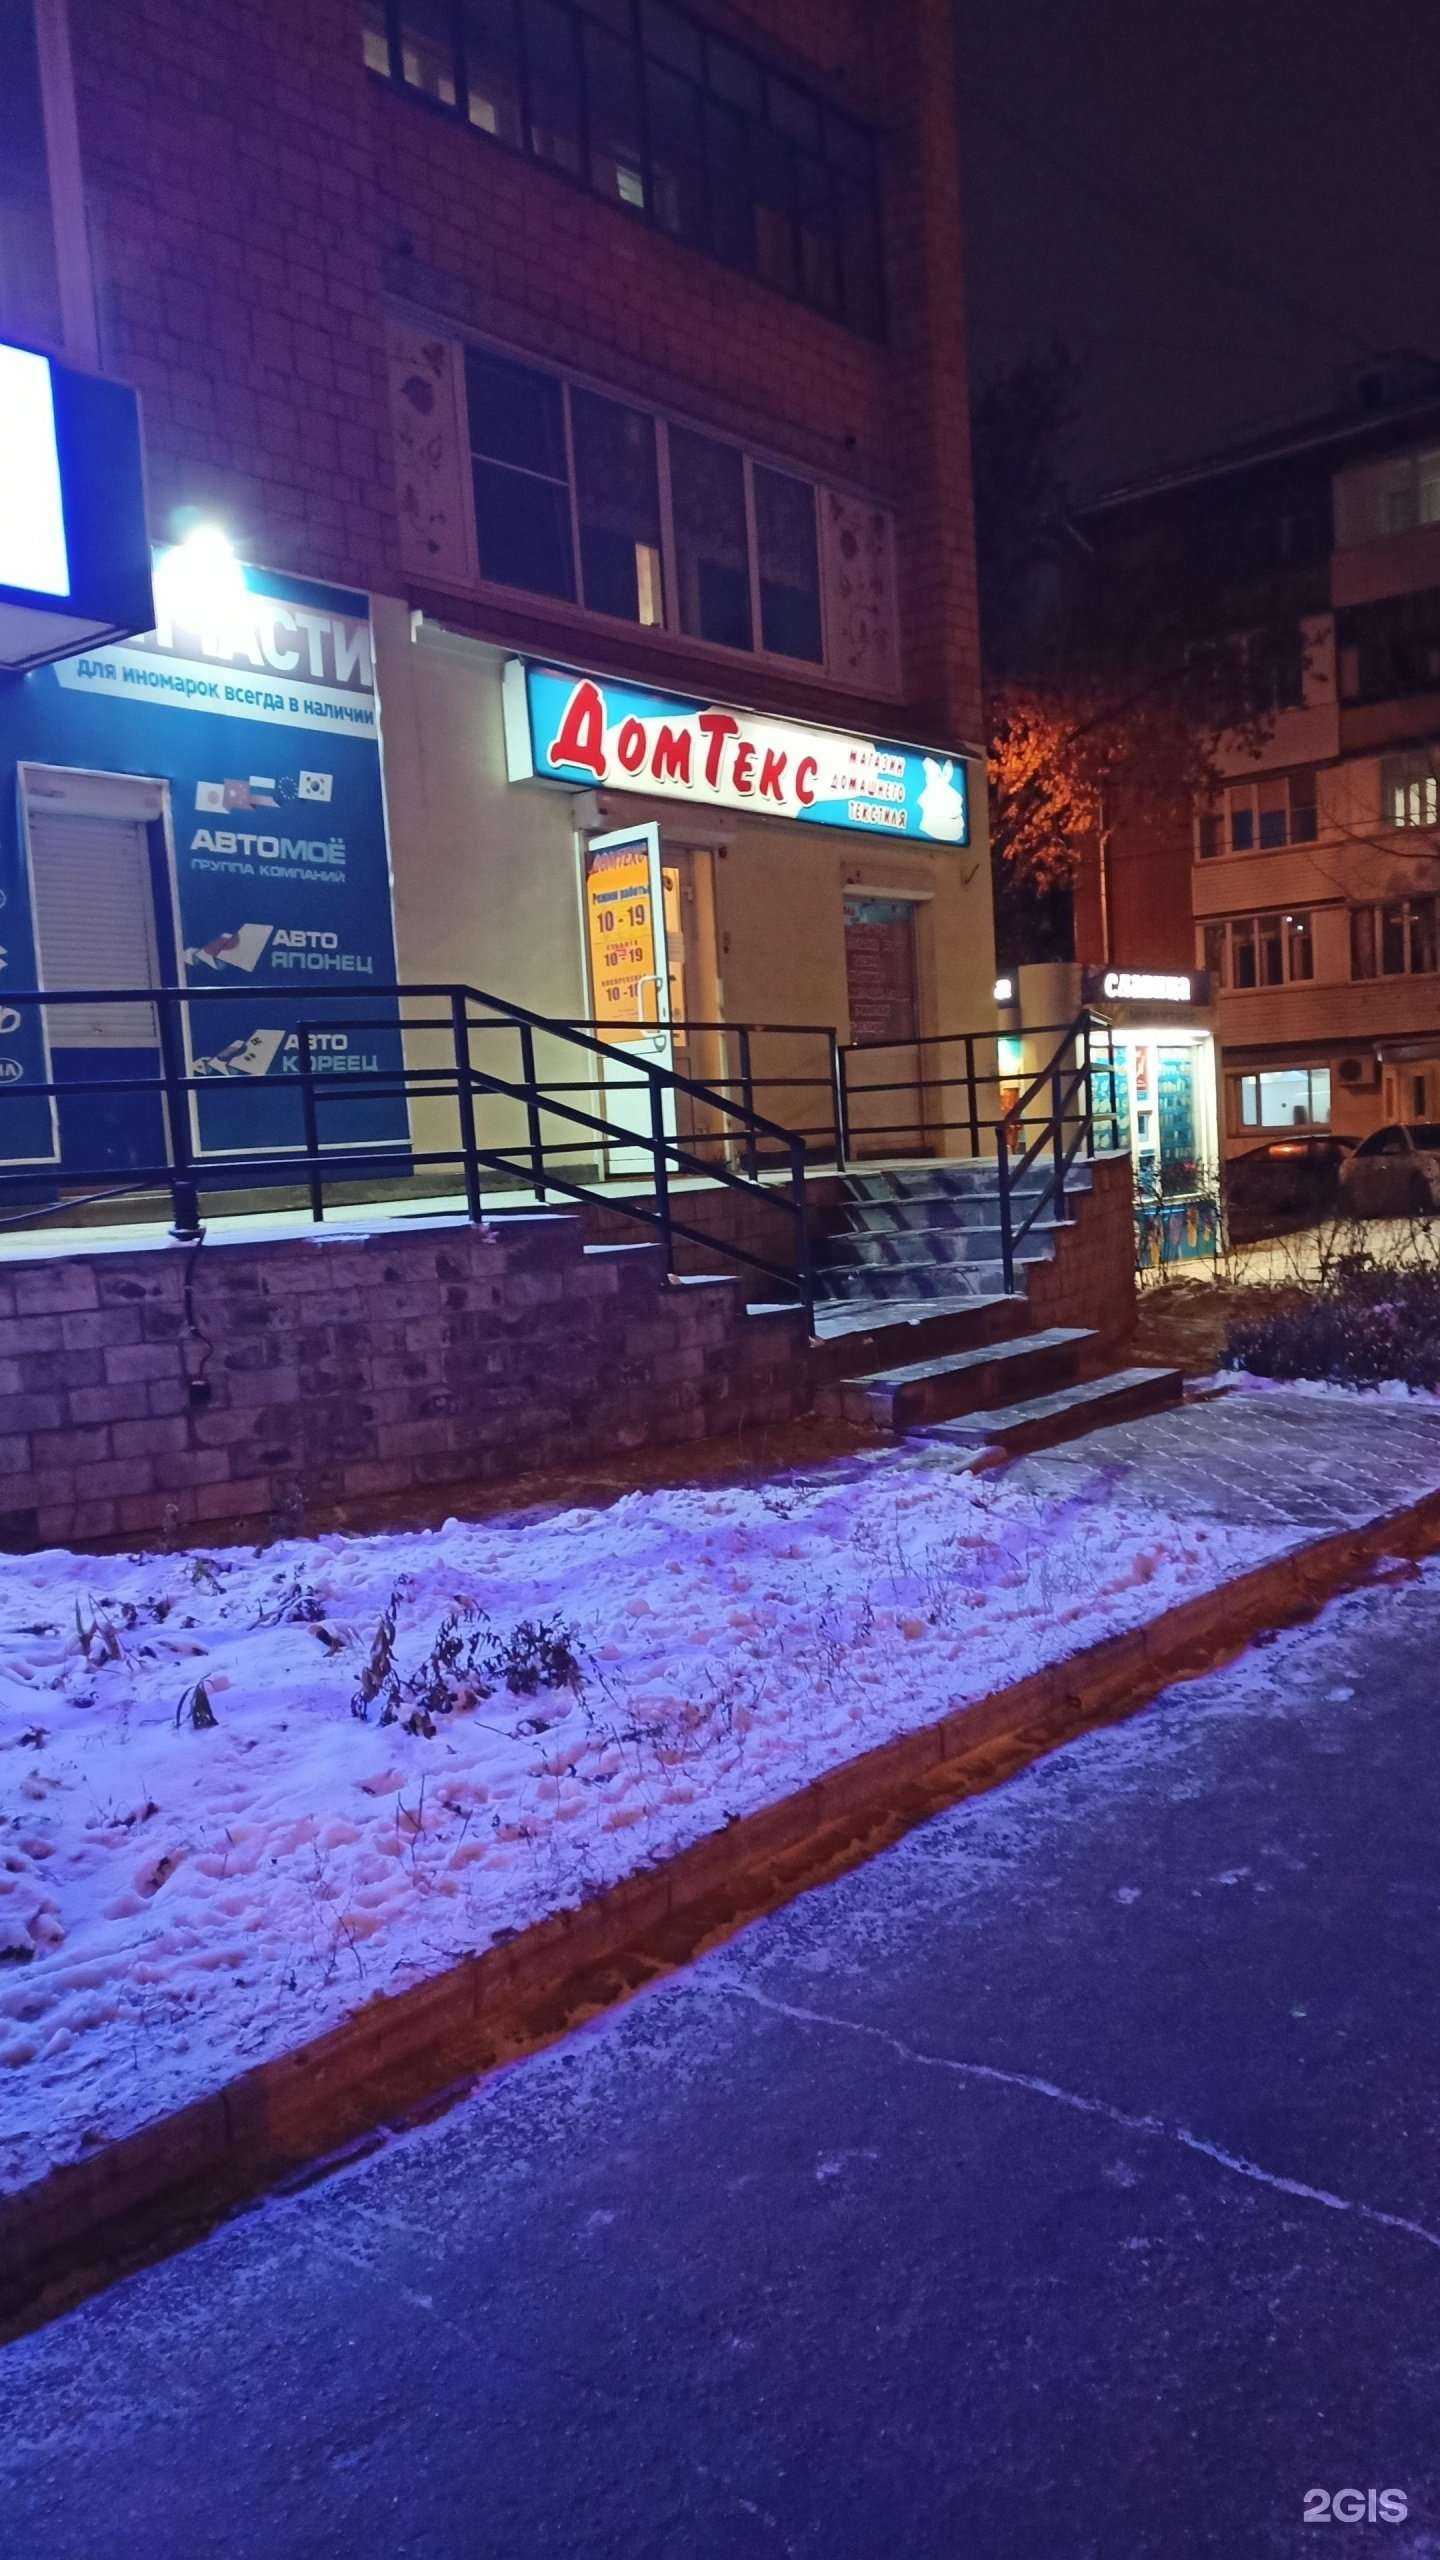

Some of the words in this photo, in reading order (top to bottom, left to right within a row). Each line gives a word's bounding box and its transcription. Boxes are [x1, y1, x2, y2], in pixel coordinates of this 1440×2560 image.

[77, 659, 117, 679] для
[121, 665, 221, 698] иномарок
[224, 685, 285, 711] всегда
[289, 697, 299, 712] в
[304, 700, 374, 725] наличии
[848, 750, 905, 775] МАГАЗИН
[829, 773, 906, 801] ДОМАШНЕГО
[848, 800, 906, 828] ТЕКСТИЛЯ
[190, 828, 346, 865] АВТОМОЁ
[191, 858, 255, 876] ГРУППА
[259, 864, 346, 883] КОМПАНИЙ
[597, 910, 615, 933] 10
[627, 903, 646, 927] 19
[272, 929, 338, 949] АВТО
[271, 951, 374, 974] ЯПОНЕЦ
[604, 952, 618, 967] 10
[629, 947, 643, 963] 19
[606, 986, 620, 1002] 10
